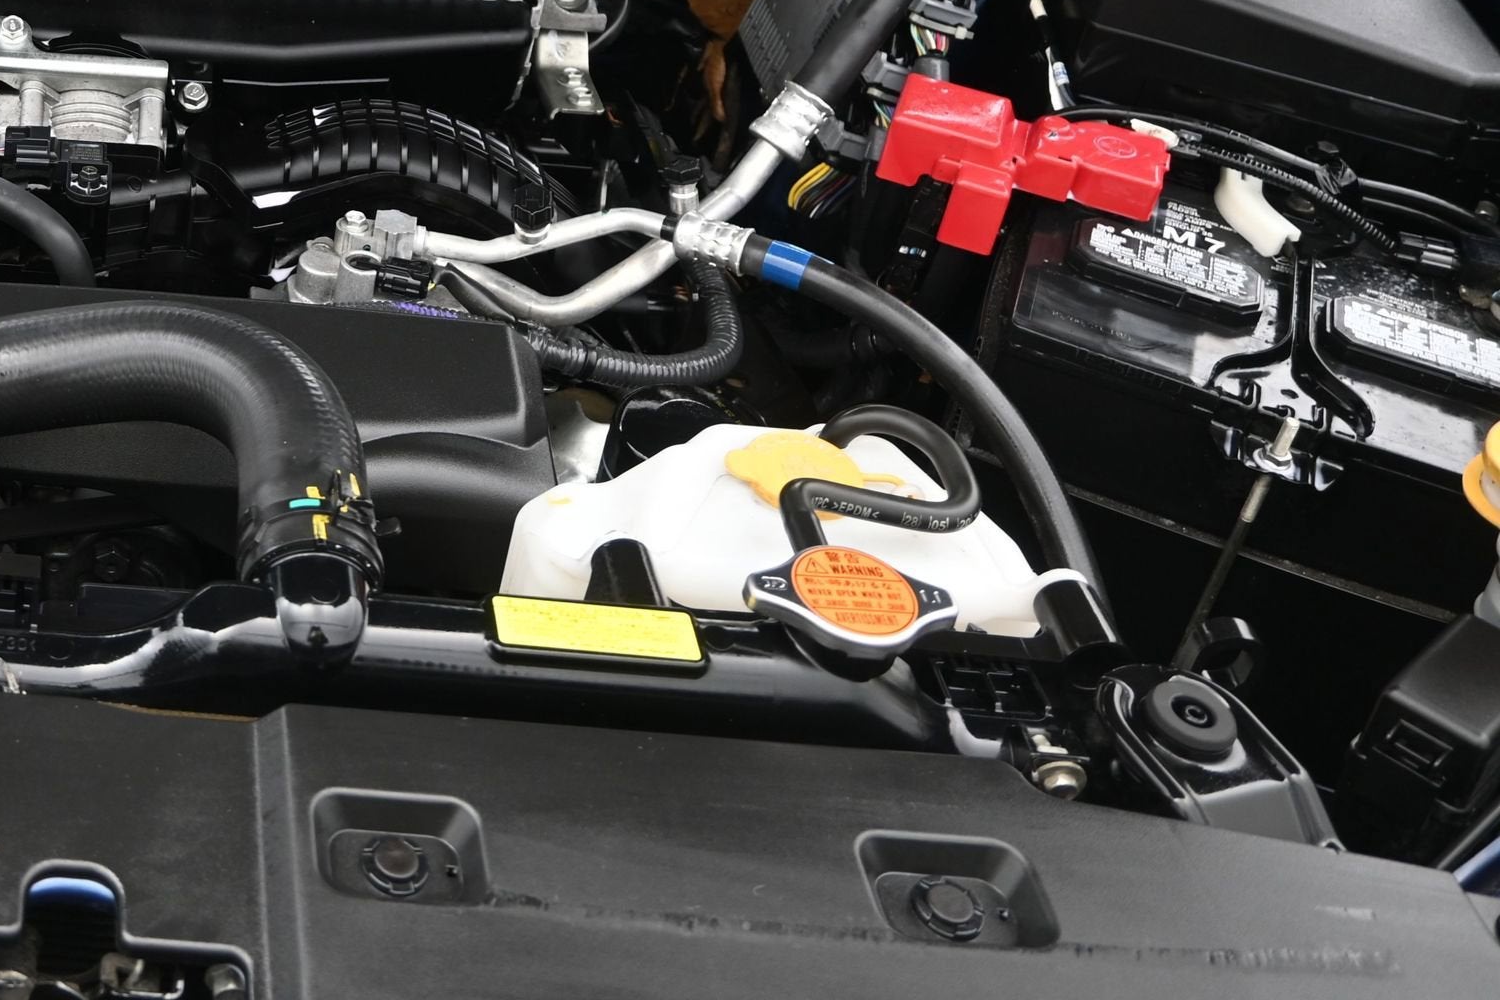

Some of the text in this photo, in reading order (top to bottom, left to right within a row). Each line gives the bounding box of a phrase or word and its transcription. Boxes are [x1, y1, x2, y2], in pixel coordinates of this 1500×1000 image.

[1134, 231, 1203, 259] DANGER/POISON
[1163, 225, 1226, 254] M 7
[829, 564, 884, 578] WARNING
